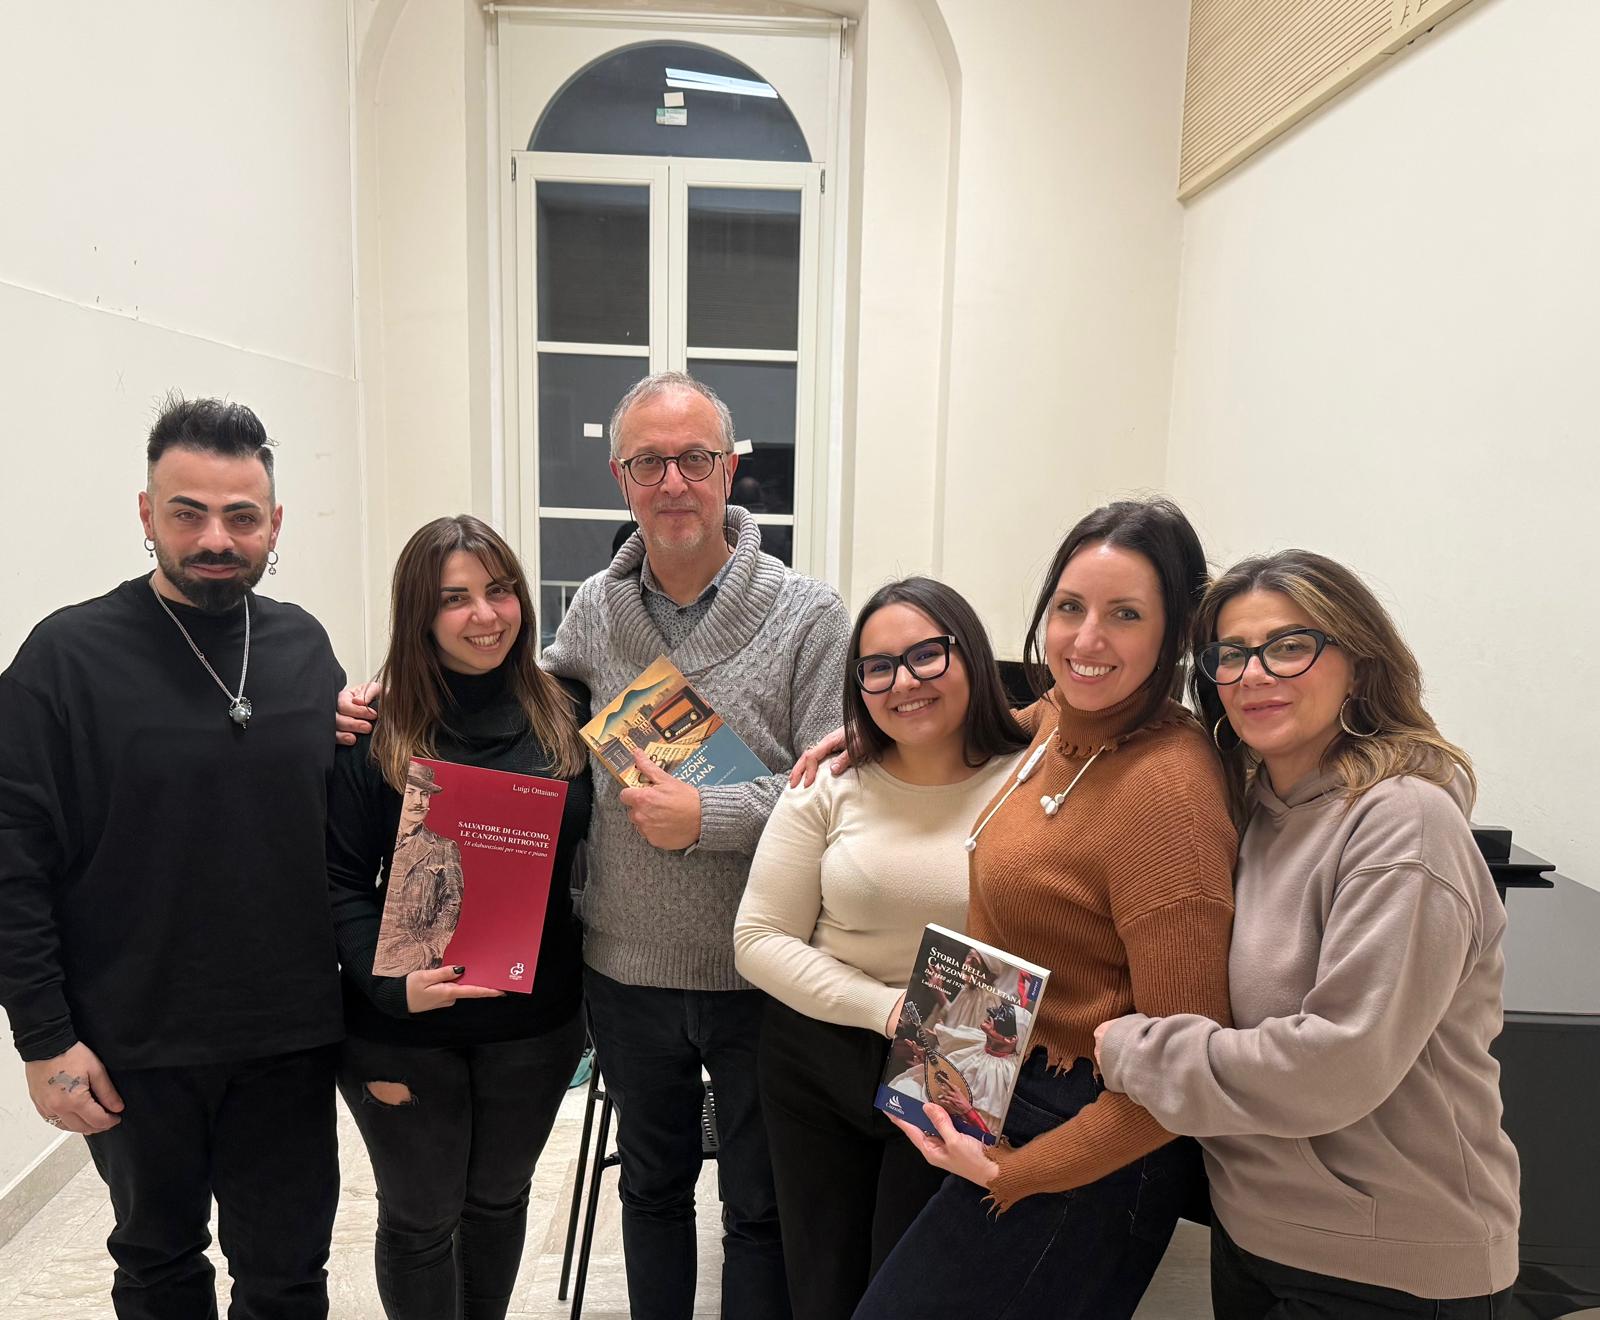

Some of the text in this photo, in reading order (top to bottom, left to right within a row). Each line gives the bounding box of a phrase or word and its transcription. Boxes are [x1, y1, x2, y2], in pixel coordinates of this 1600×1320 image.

[677, 754, 708, 780] NZONE
[513, 784, 530, 793] Luigi
[458, 821, 501, 833] SALVATORE
[460, 830, 549, 849] LE CANZONI RITROVATE
[471, 841, 505, 851] elaborazioni
[504, 846, 514, 854] per
[532, 850, 548, 858] piano
[929, 946, 986, 979] STORIA DELLA
[928, 956, 967, 981] CANZONE
[969, 975, 1022, 1006] NAPOLETANA
